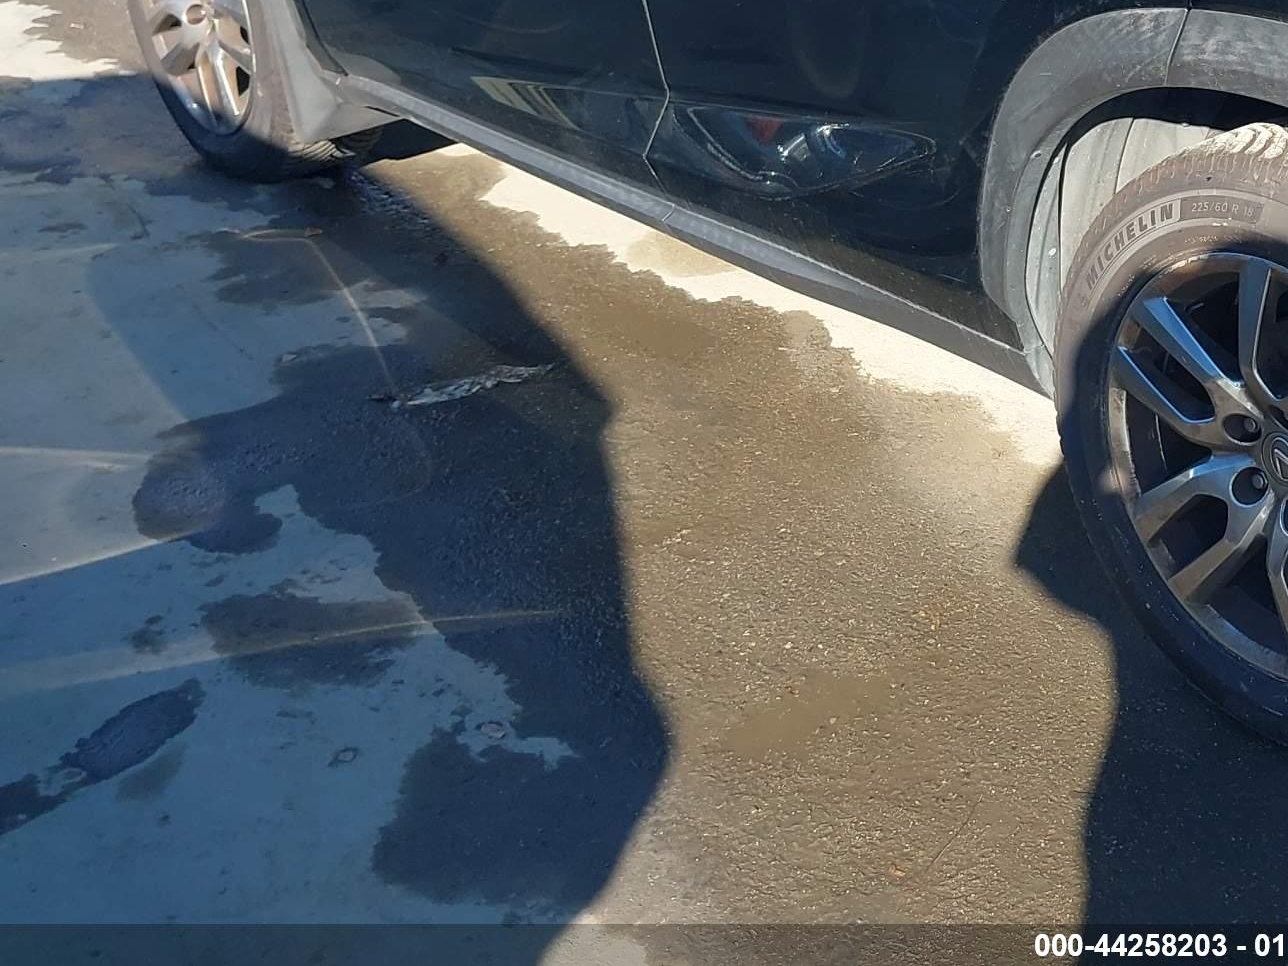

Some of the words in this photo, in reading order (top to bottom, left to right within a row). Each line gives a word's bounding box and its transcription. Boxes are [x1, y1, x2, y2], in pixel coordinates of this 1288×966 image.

[1085, 202, 1174, 291] MICHELIN
[1191, 201, 1228, 213] 225/60
[1231, 203, 1239, 214] R
